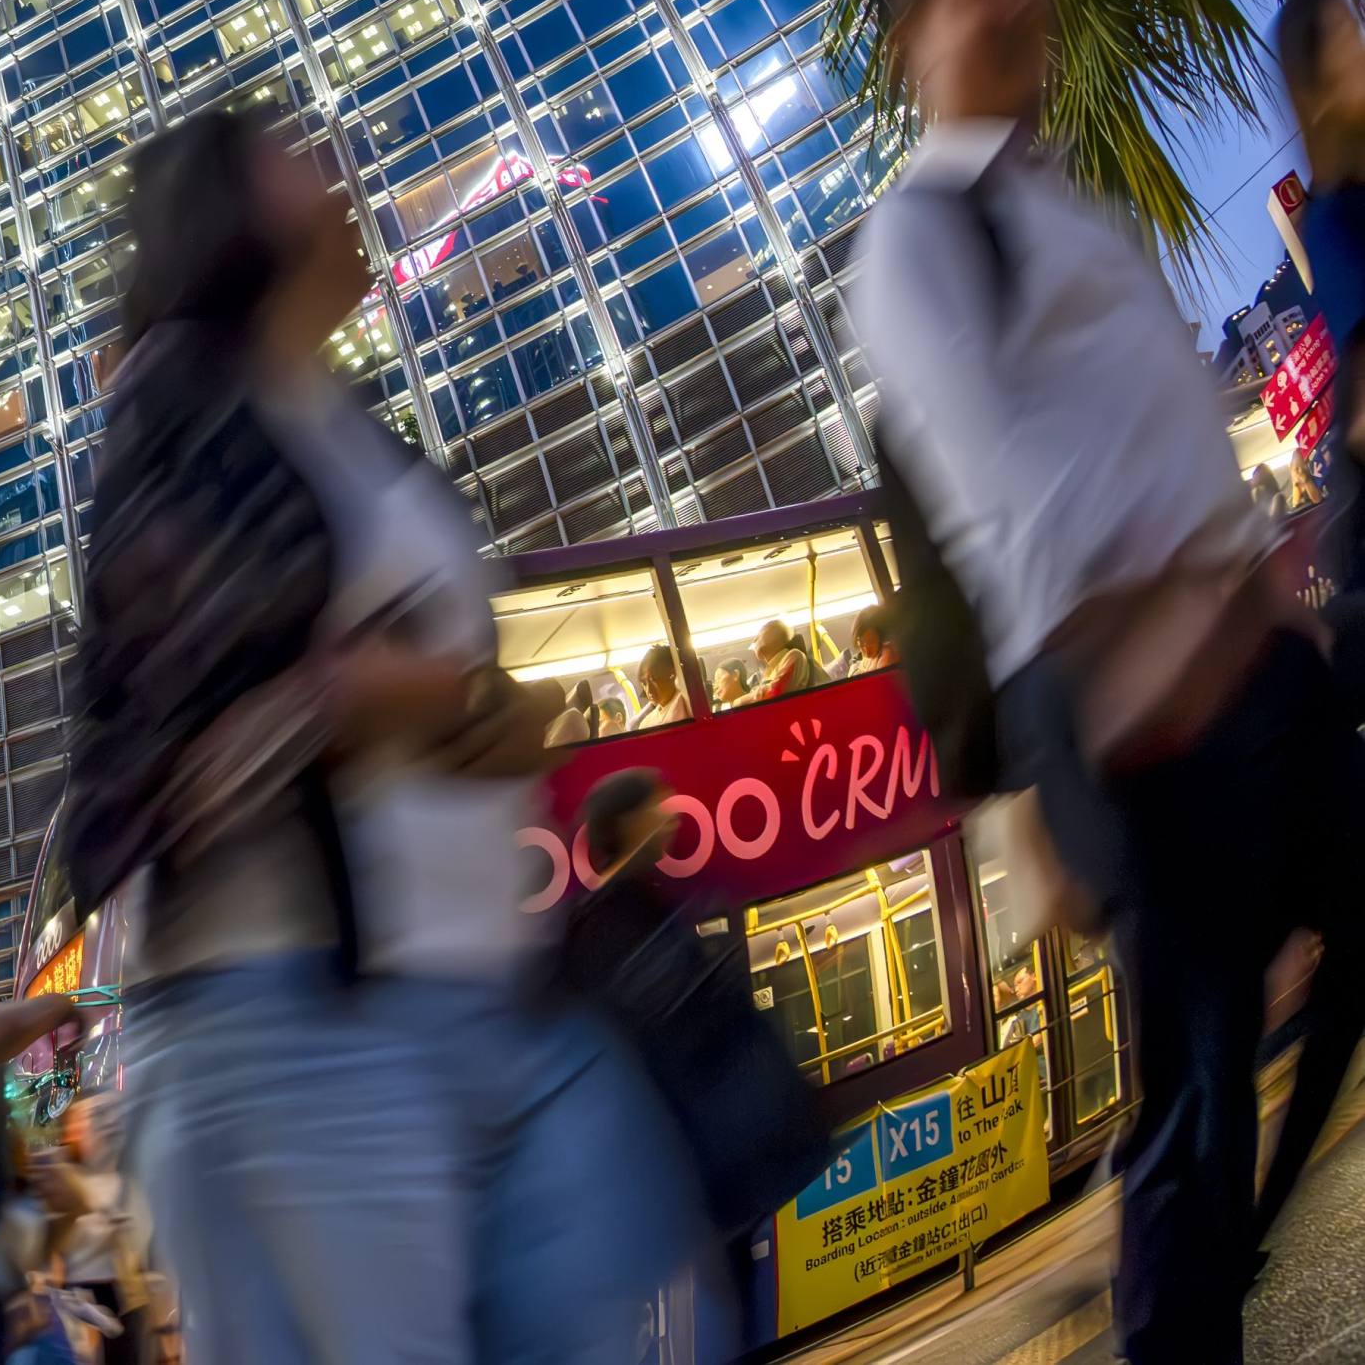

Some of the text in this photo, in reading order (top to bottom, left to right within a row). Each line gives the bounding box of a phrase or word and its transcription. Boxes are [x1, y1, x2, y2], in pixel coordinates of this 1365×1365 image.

[801, 726, 940, 840] CRM
[889, 1110, 940, 1163] X15
[958, 1099, 1024, 1144] to The eak
[805, 1243, 856, 1271] Boarding
[907, 1199, 947, 1226] outside
